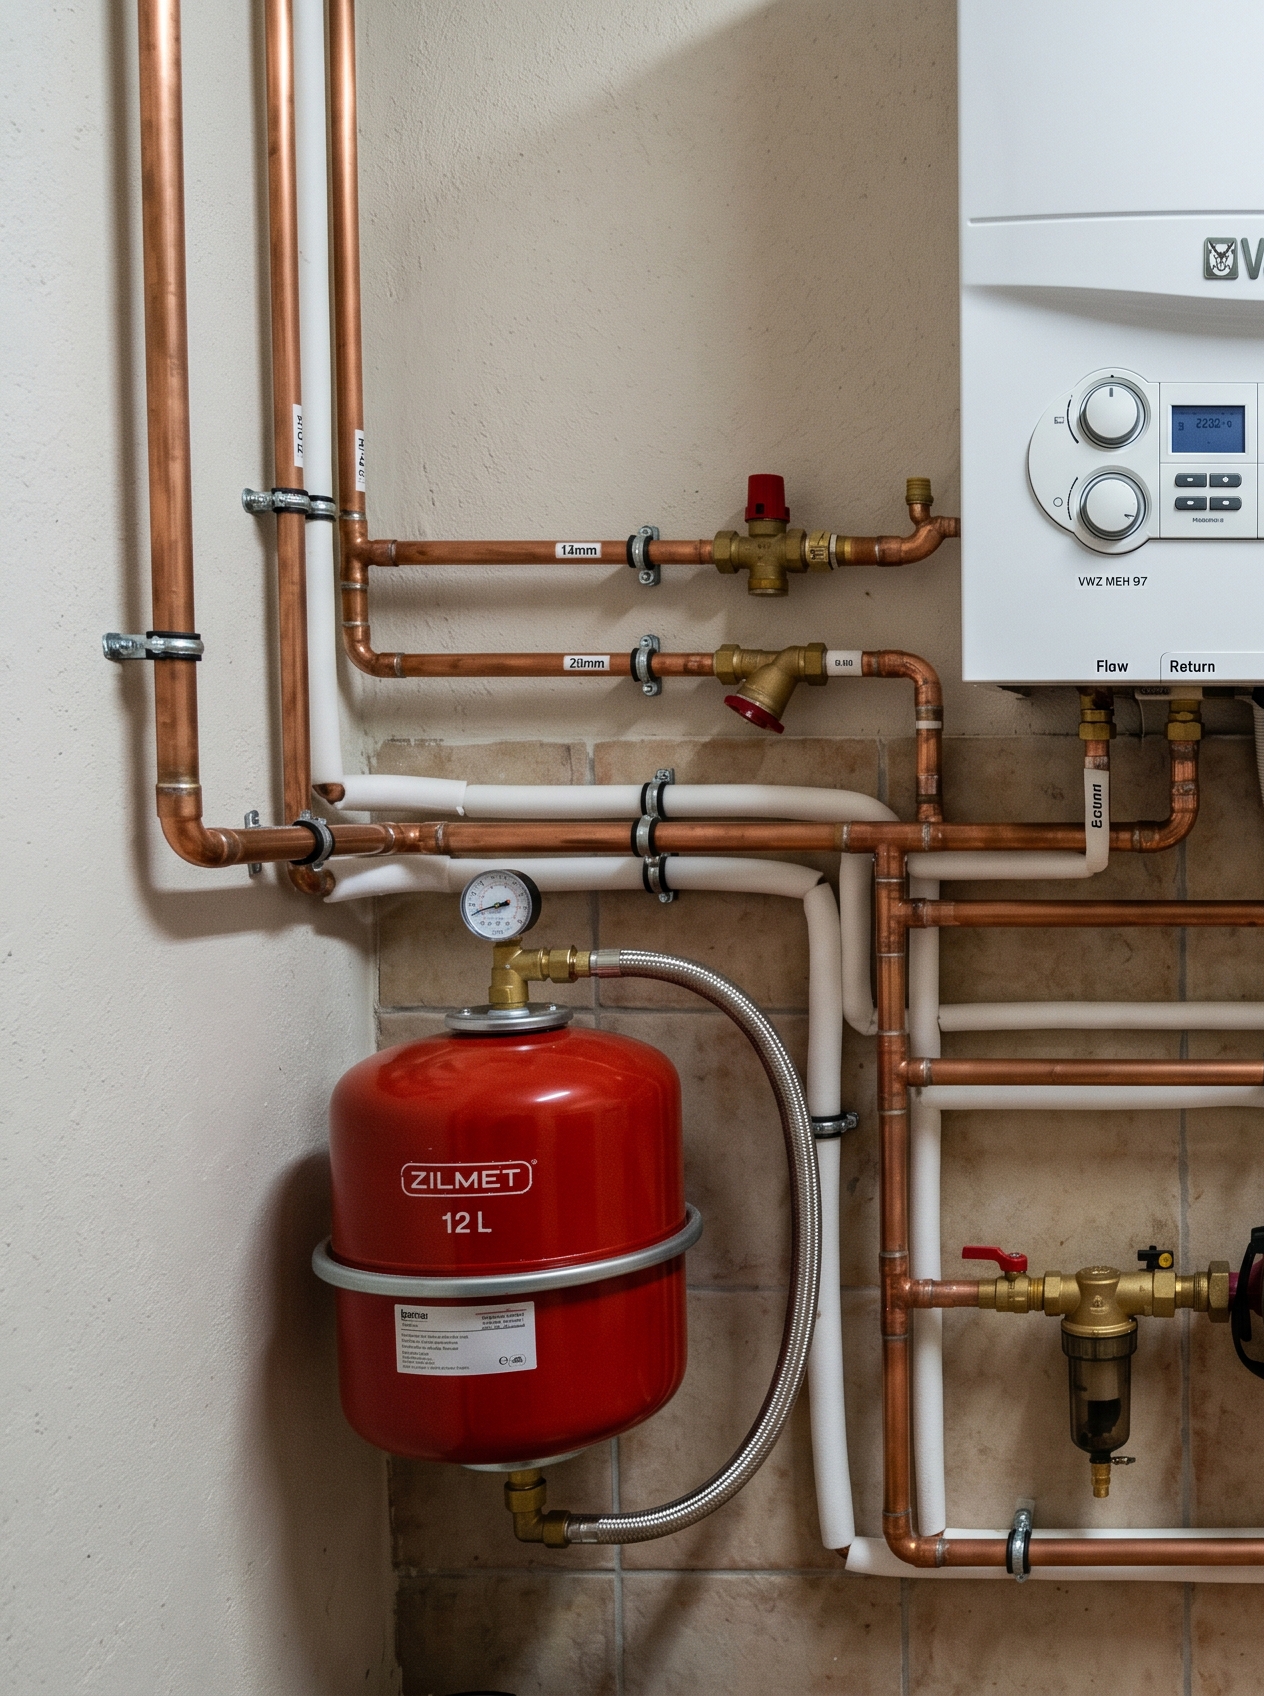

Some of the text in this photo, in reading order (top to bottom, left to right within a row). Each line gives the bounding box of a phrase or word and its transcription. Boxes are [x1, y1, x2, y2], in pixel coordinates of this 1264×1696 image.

[1078, 576, 1148, 587] VWZ MEH 97
[1169, 659, 1216, 673] Return
[411, 1168, 521, 1190] ZILMET
[442, 1210, 493, 1234] 12 L
